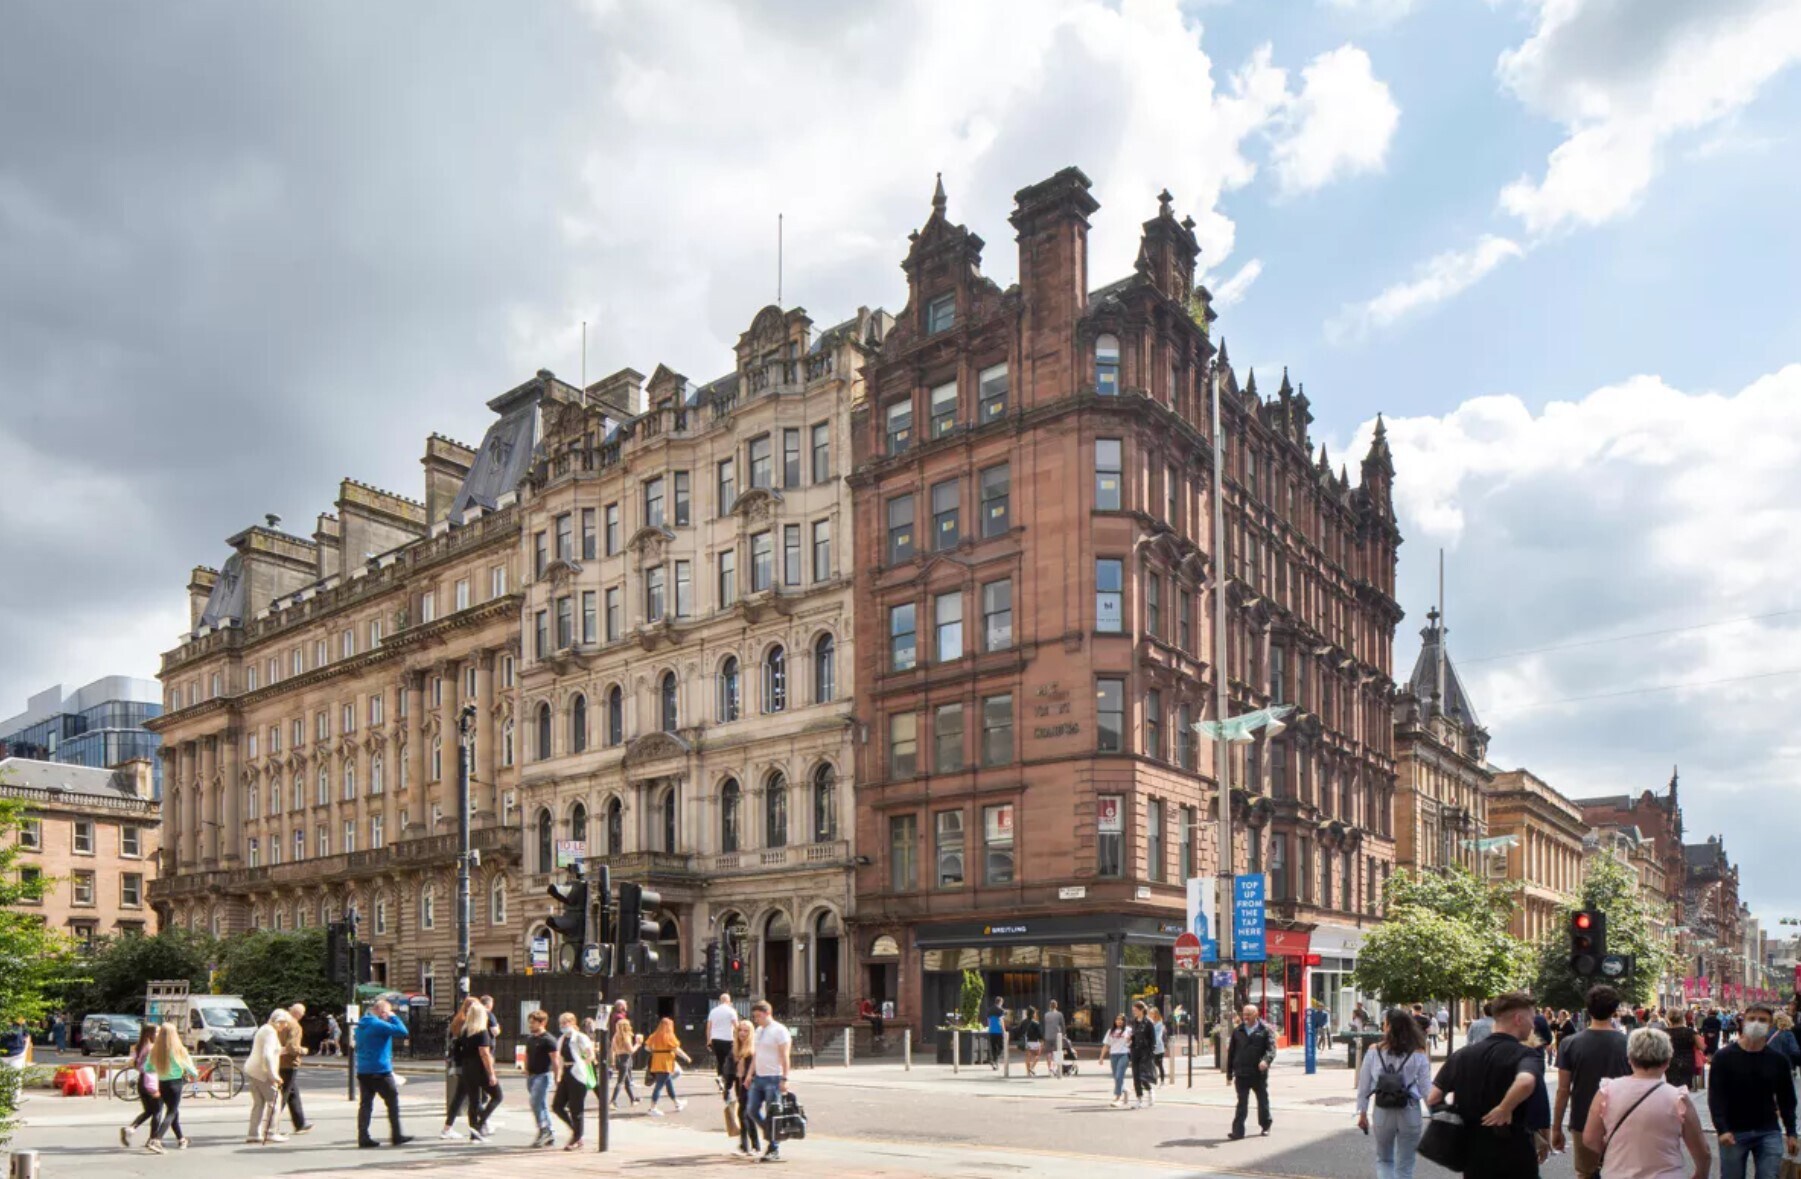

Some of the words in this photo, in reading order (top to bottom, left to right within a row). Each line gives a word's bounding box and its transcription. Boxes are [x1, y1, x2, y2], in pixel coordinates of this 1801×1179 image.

[574, 841, 585, 850] LE
[1241, 881, 1258, 889] TOP
[1236, 900, 1262, 908] FROM
[1241, 909, 1258, 917] THE
[1241, 918, 1258, 926] TAP
[1238, 928, 1262, 936] HERE
